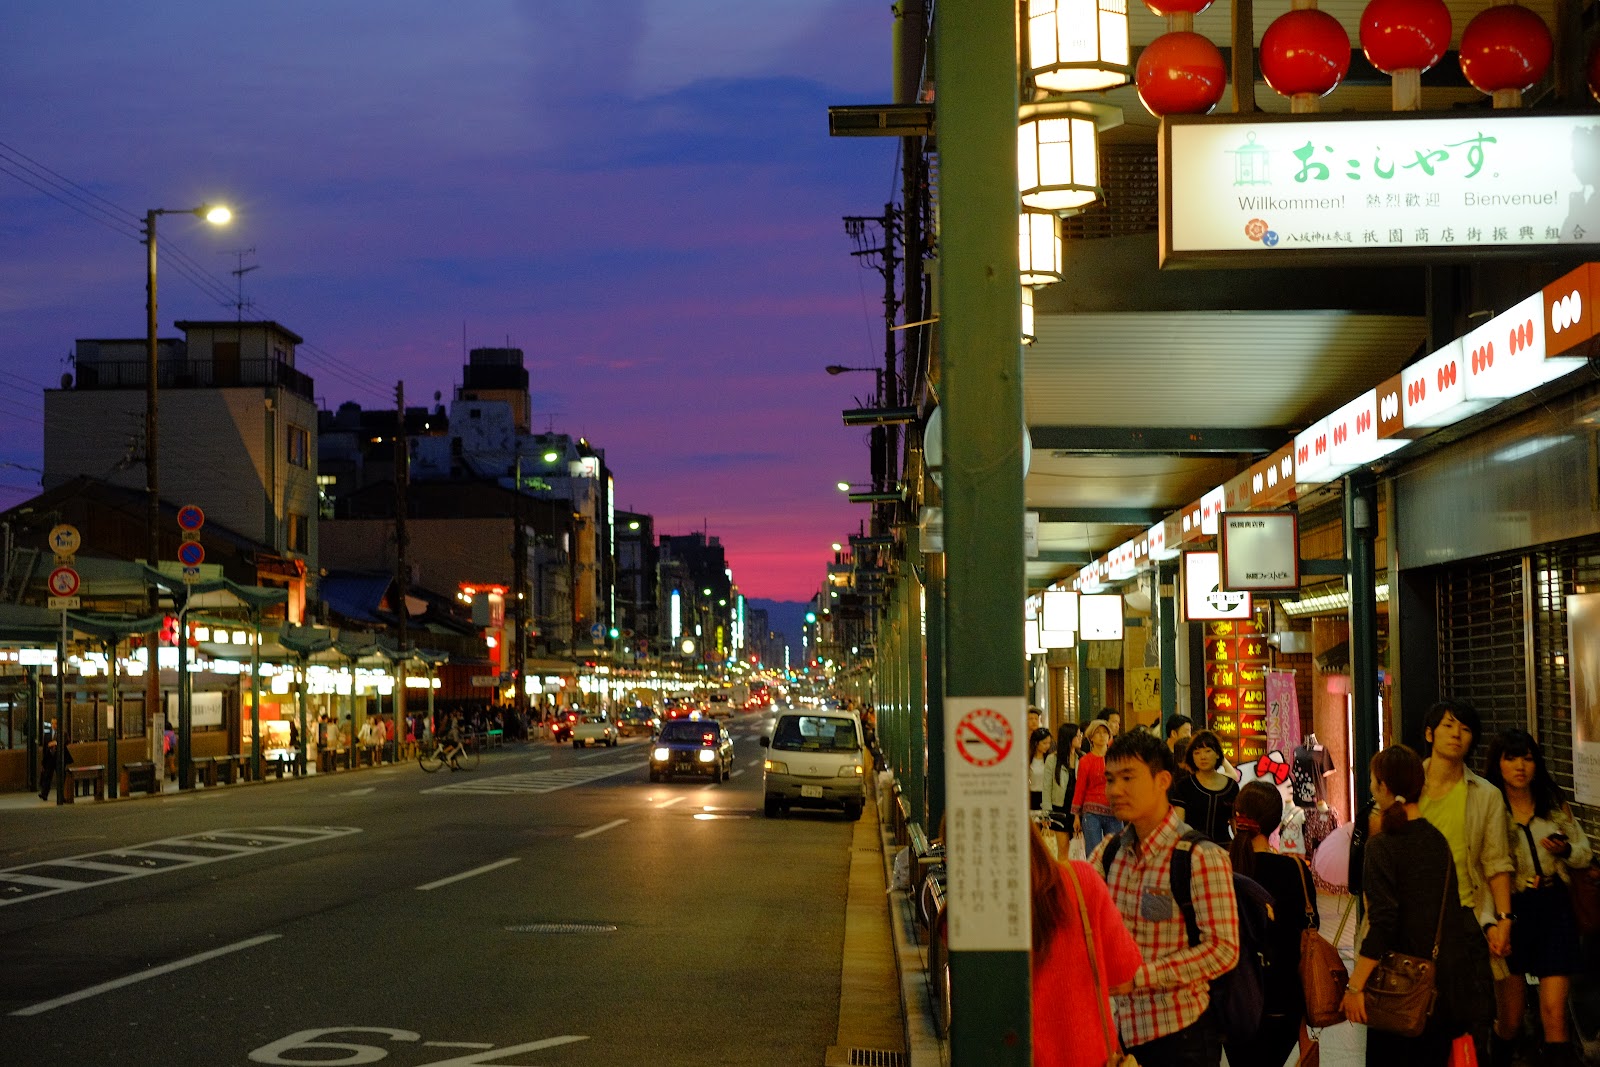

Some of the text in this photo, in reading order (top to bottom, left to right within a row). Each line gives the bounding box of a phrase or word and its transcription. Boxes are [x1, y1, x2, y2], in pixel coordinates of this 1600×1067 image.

[1292, 131, 1500, 184] おこしやす。
[1238, 195, 1346, 211] Willkommen!
[1464, 190, 1559, 207] Bienvenue!
